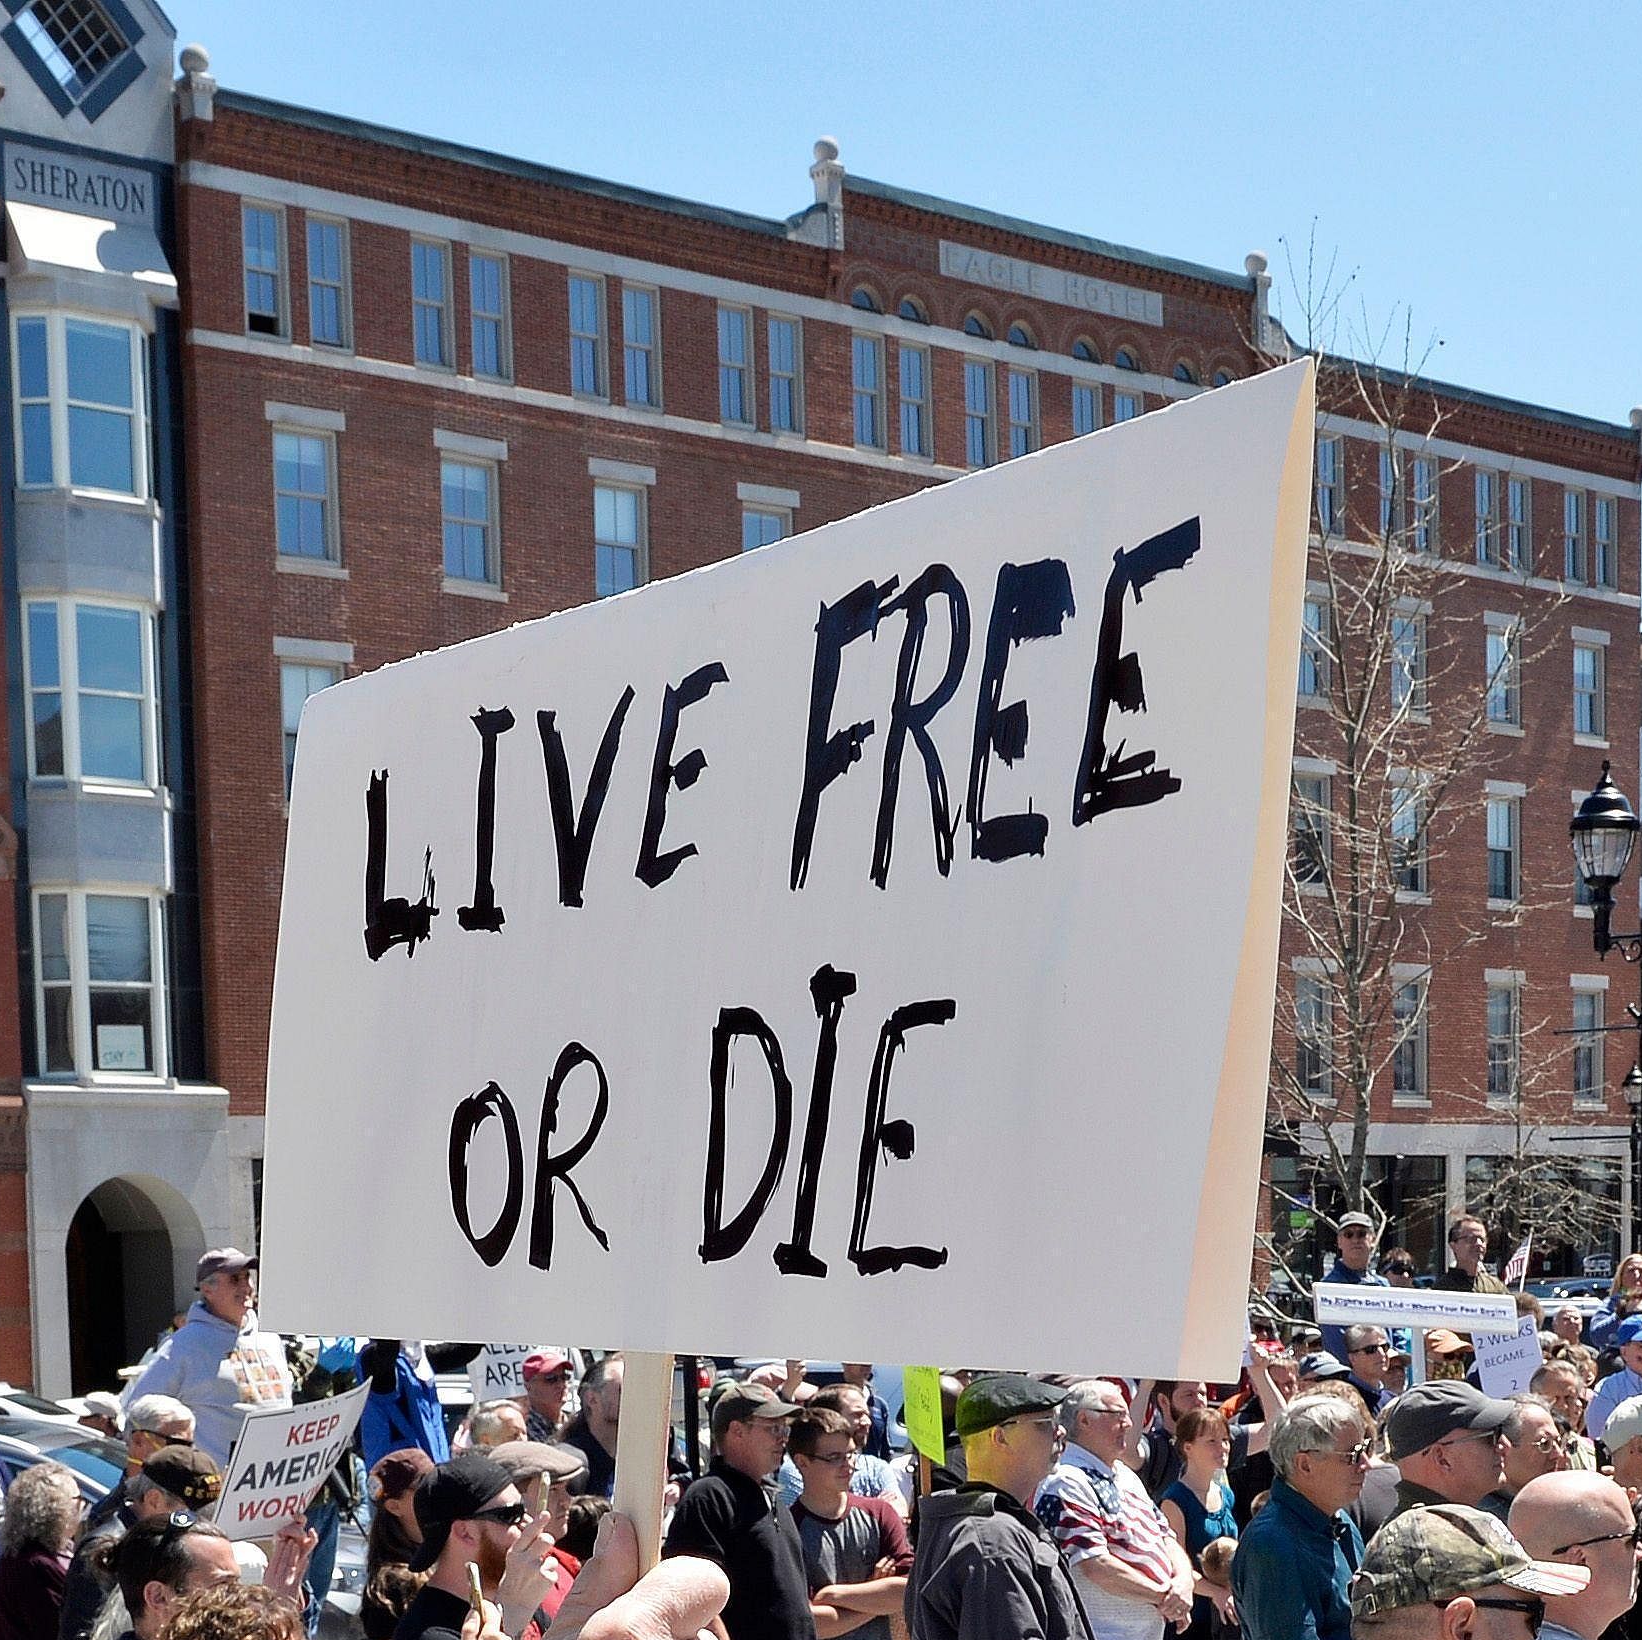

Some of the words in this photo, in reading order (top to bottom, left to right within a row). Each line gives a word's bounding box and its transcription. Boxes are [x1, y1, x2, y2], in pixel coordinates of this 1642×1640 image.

[13, 155, 147, 215] SHERATON
[945, 243, 1044, 294] EAGLE
[1063, 272, 1159, 322] HOTEL
[364, 660, 731, 962] LIVE
[789, 515, 1202, 892] FREE
[448, 1041, 612, 1271] OR
[697, 963, 957, 1277] DIE
[1388, 1301, 1404, 1309] End
[1412, 1302, 1437, 1312] Where
[1439, 1304, 1458, 1313] Your
[1477, 1337, 1486, 1350] 2
[1488, 1323, 1534, 1346] WEEKS
[1510, 1379, 1519, 1391] 2
[286, 1413, 341, 1448] KEEP
